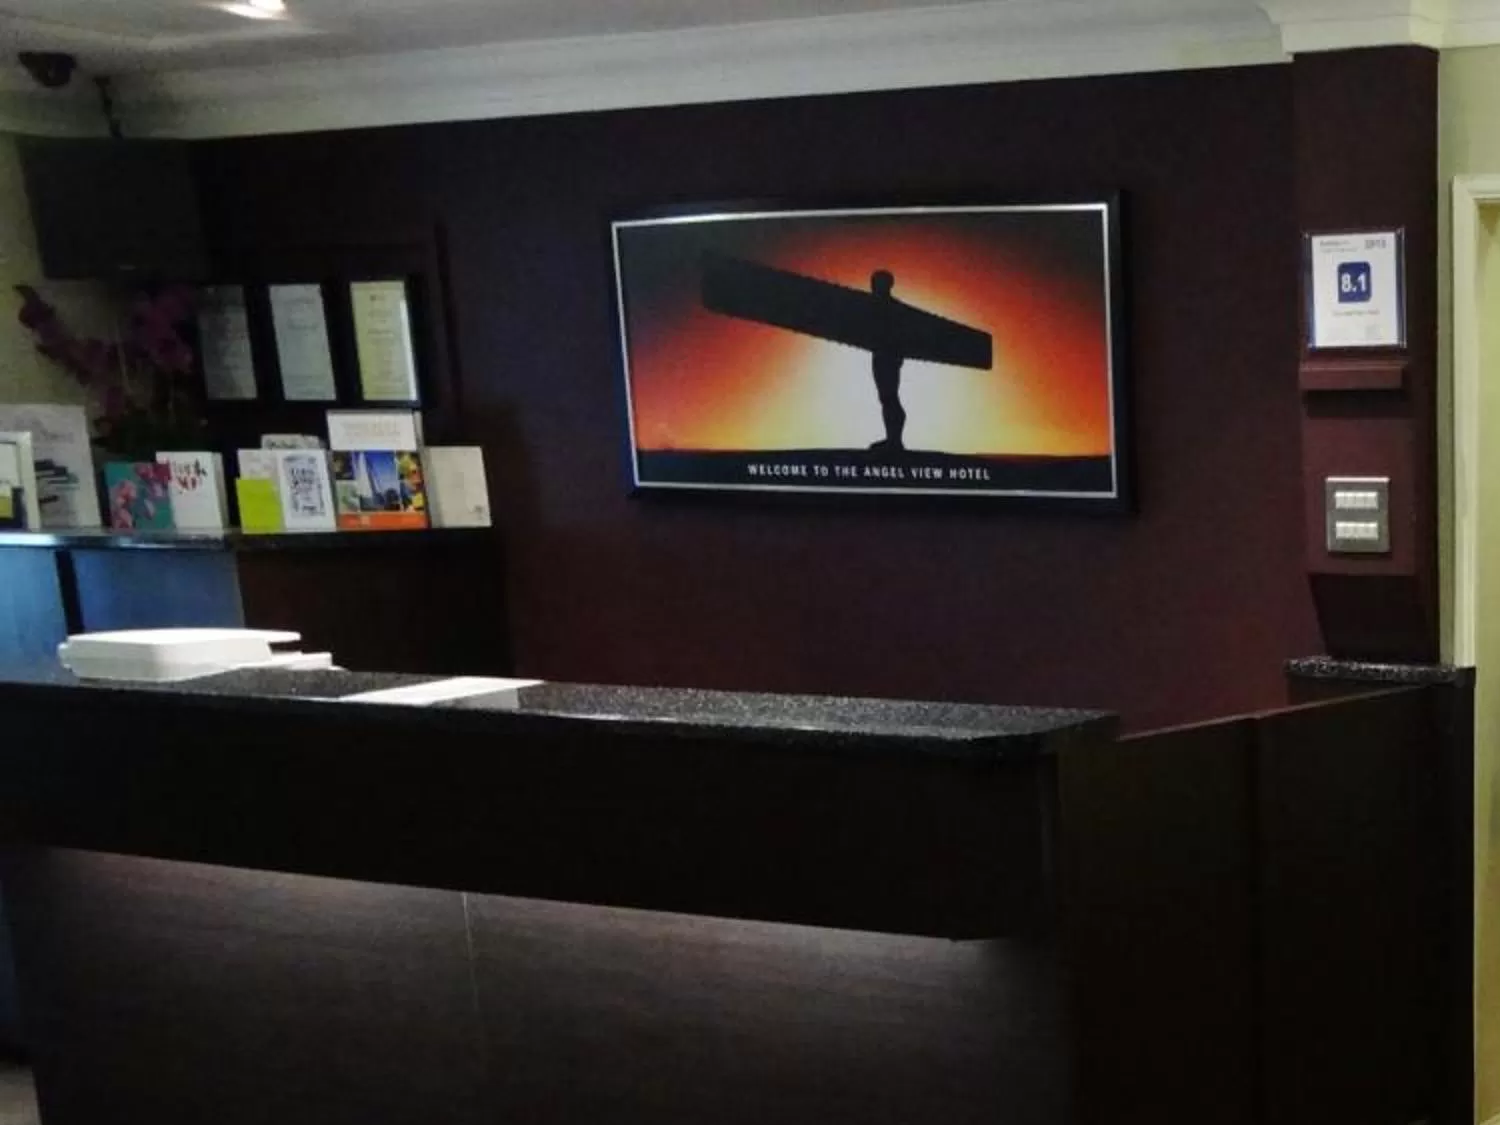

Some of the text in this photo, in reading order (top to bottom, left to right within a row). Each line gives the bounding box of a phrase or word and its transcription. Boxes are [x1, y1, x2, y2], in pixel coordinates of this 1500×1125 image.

[1341, 272, 1367, 293] 8.1
[747, 463, 990, 481] WELCOME TO THE ANGEL VIEW HOTEL
